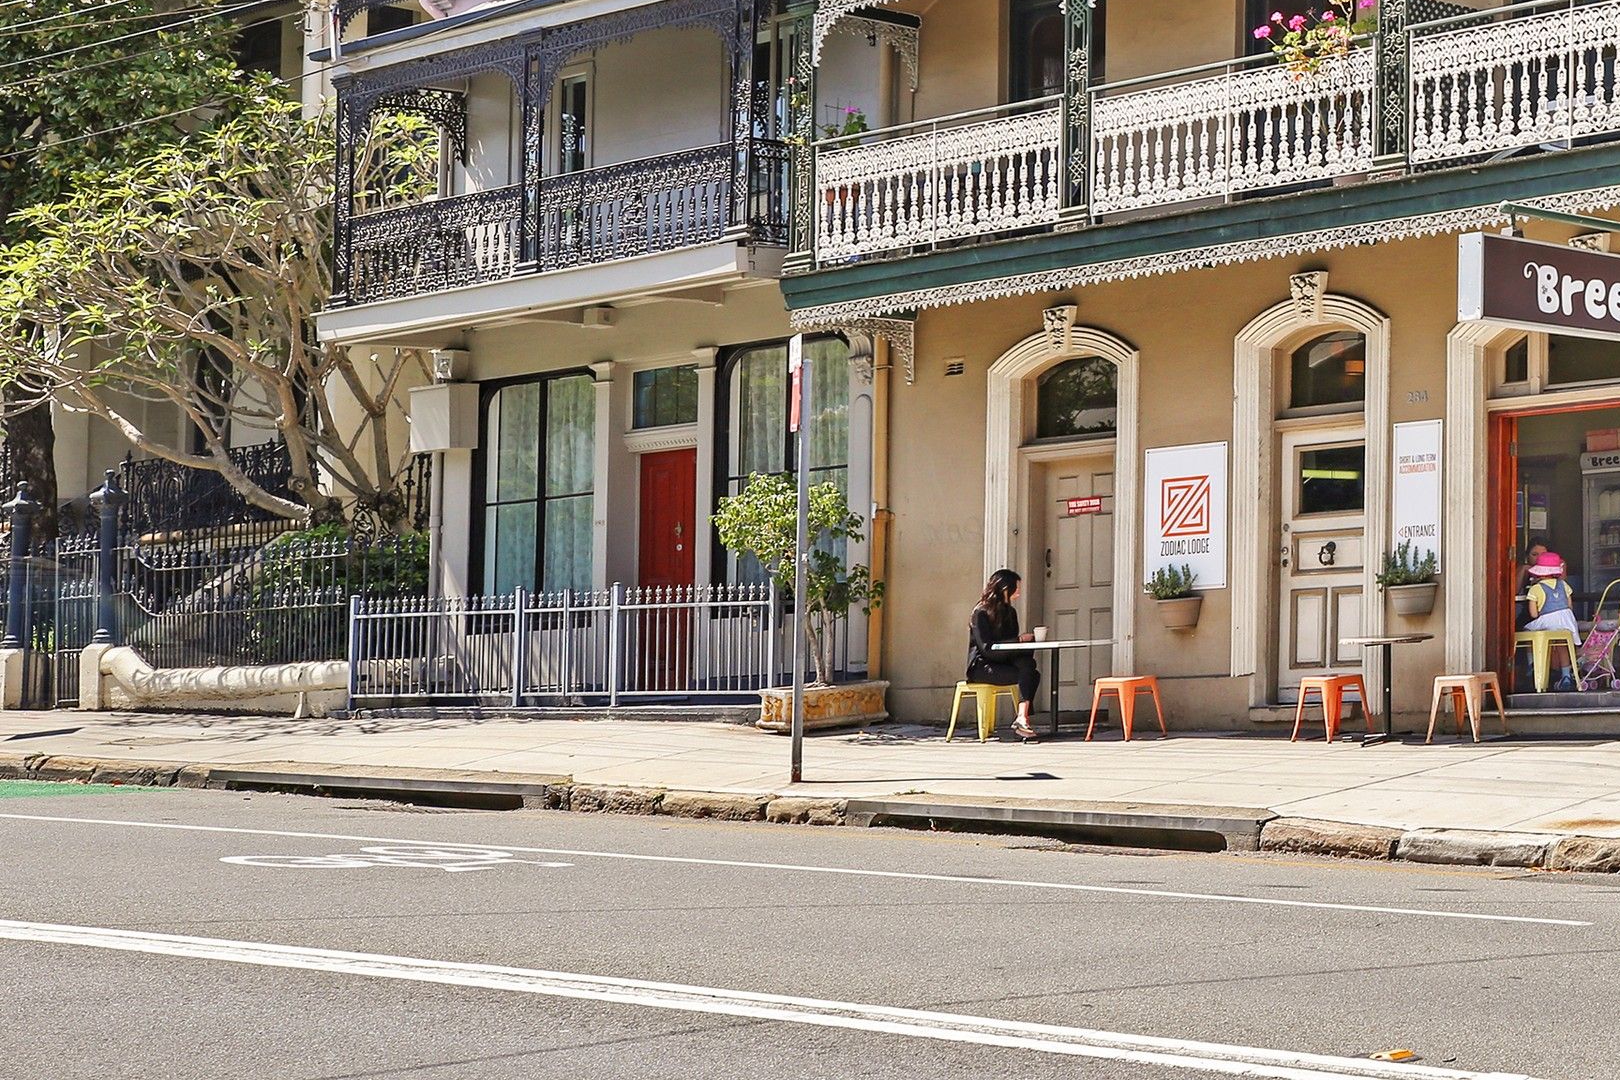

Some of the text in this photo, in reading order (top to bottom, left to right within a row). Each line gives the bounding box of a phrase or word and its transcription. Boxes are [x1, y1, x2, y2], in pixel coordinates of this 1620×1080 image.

[1404, 524, 1436, 538] ENTRANCE
[1161, 538, 1210, 557] ZODIAC LODGE
